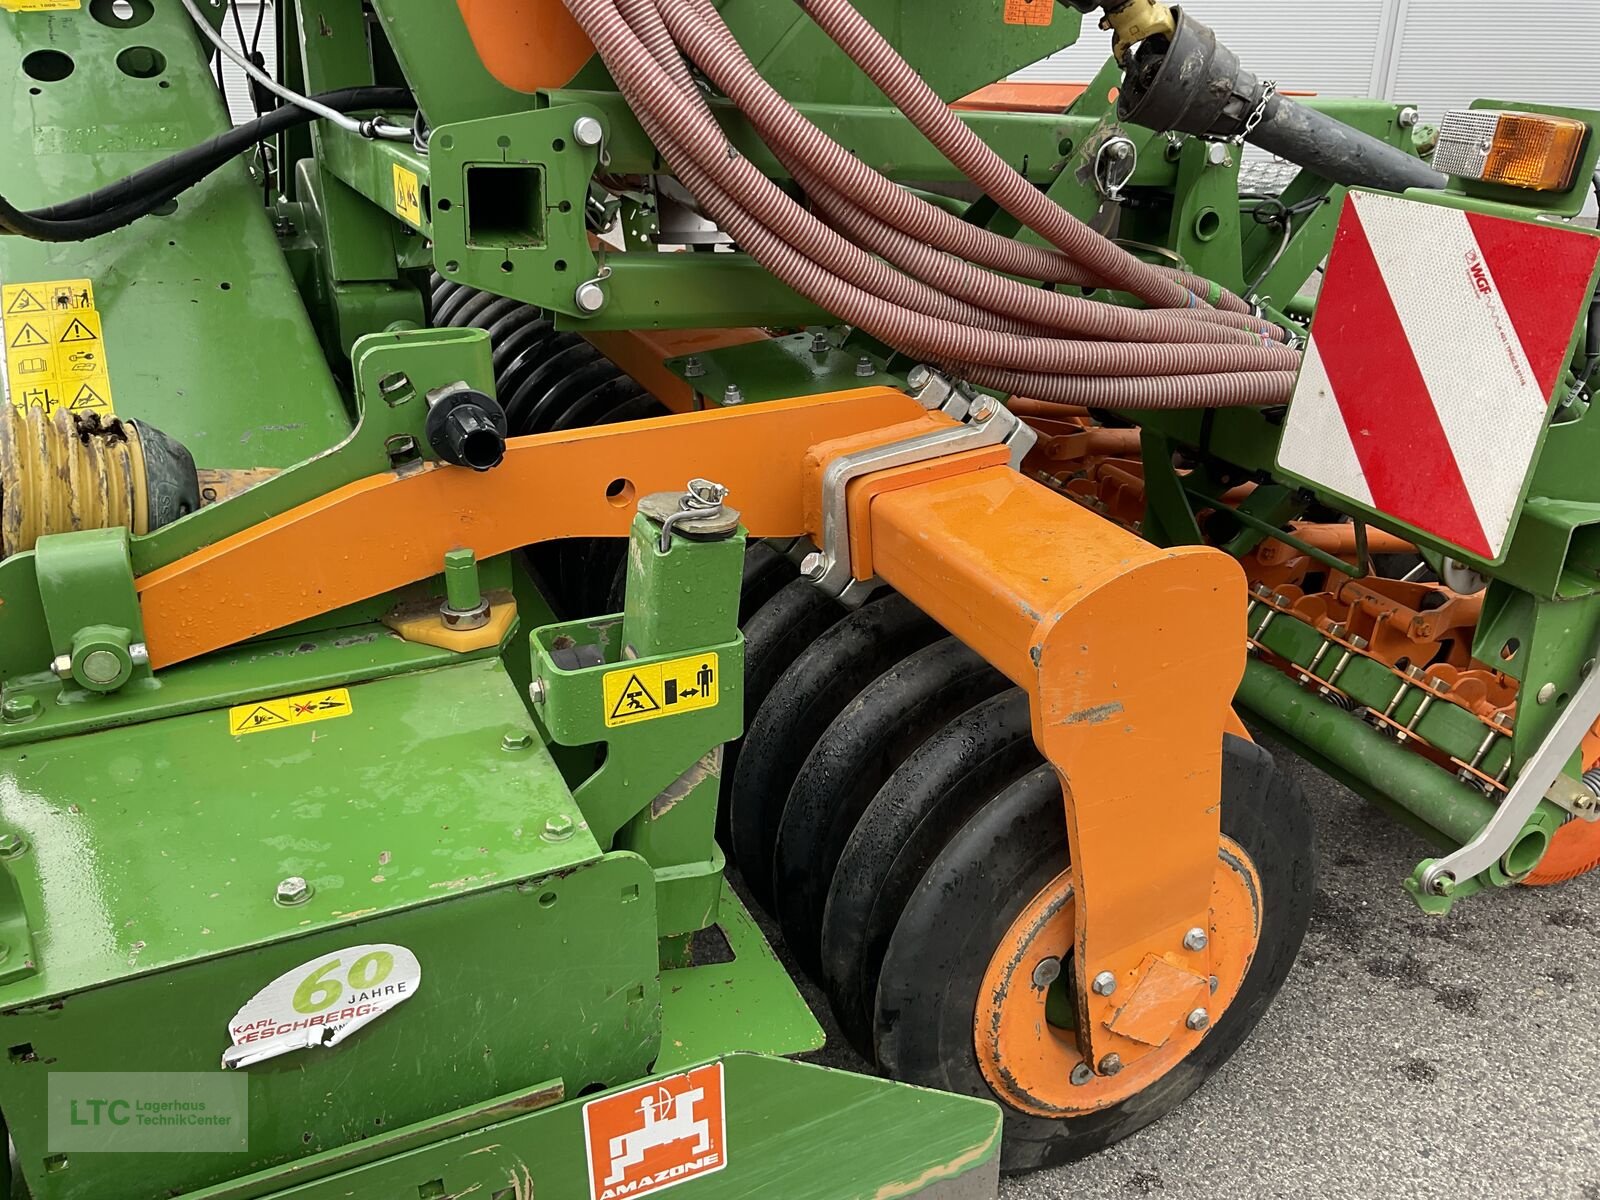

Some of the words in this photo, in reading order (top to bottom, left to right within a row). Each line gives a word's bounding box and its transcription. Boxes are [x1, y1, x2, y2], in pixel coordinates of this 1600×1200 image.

[1470, 262, 1492, 294] WGF
[292, 951, 395, 1014] 60
[348, 982, 407, 1004] JAHRE
[232, 1018, 277, 1036] KARL
[600, 1153, 719, 1200] AMAZONE
